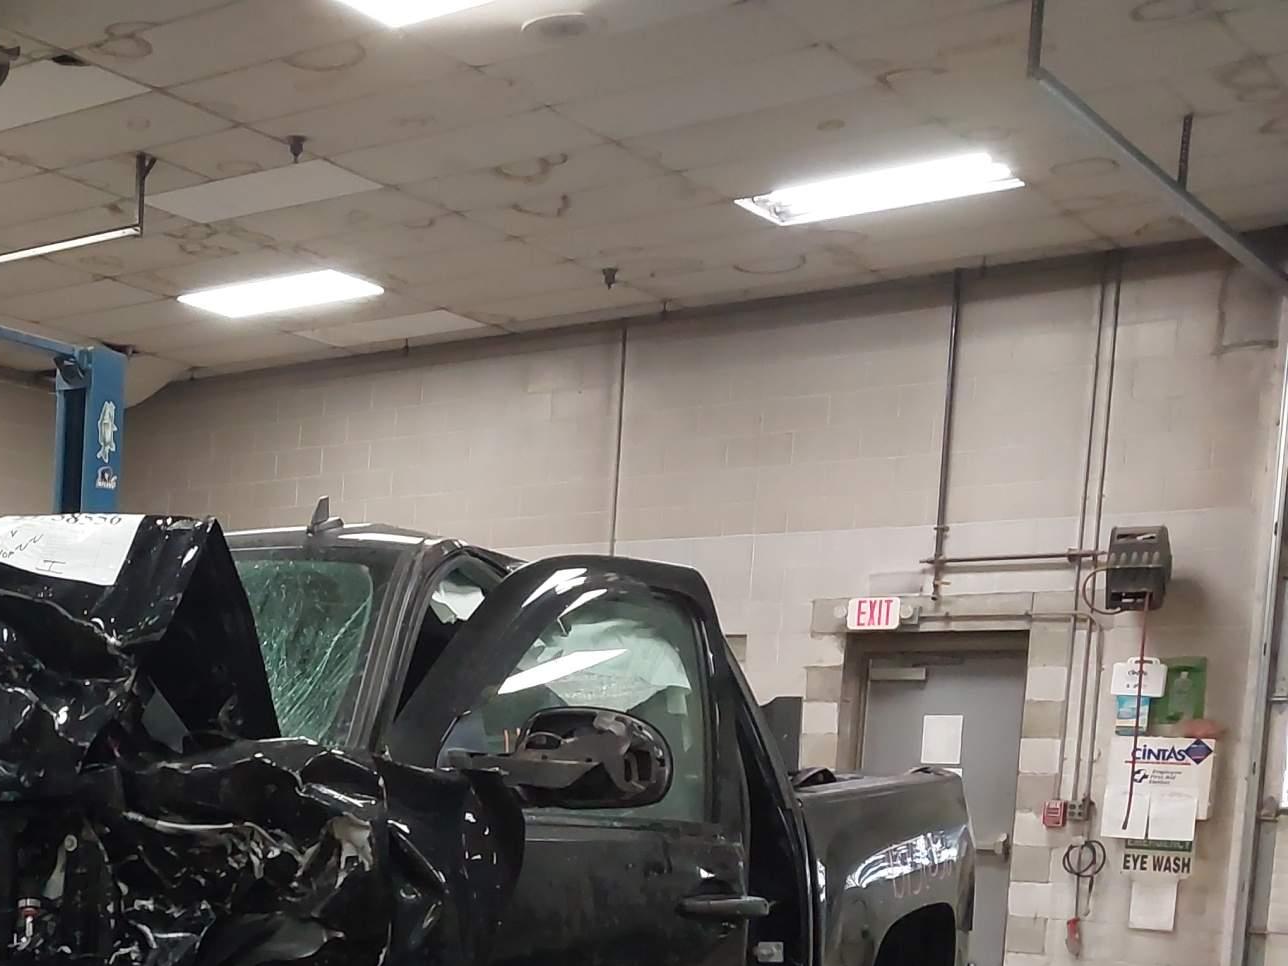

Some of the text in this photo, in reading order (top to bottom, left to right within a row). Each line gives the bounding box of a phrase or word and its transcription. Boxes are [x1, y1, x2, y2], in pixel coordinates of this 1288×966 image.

[857, 600, 893, 626] EXIT
[1132, 744, 1186, 761] CINTAS
[1123, 854, 1191, 873] EYE WASH
